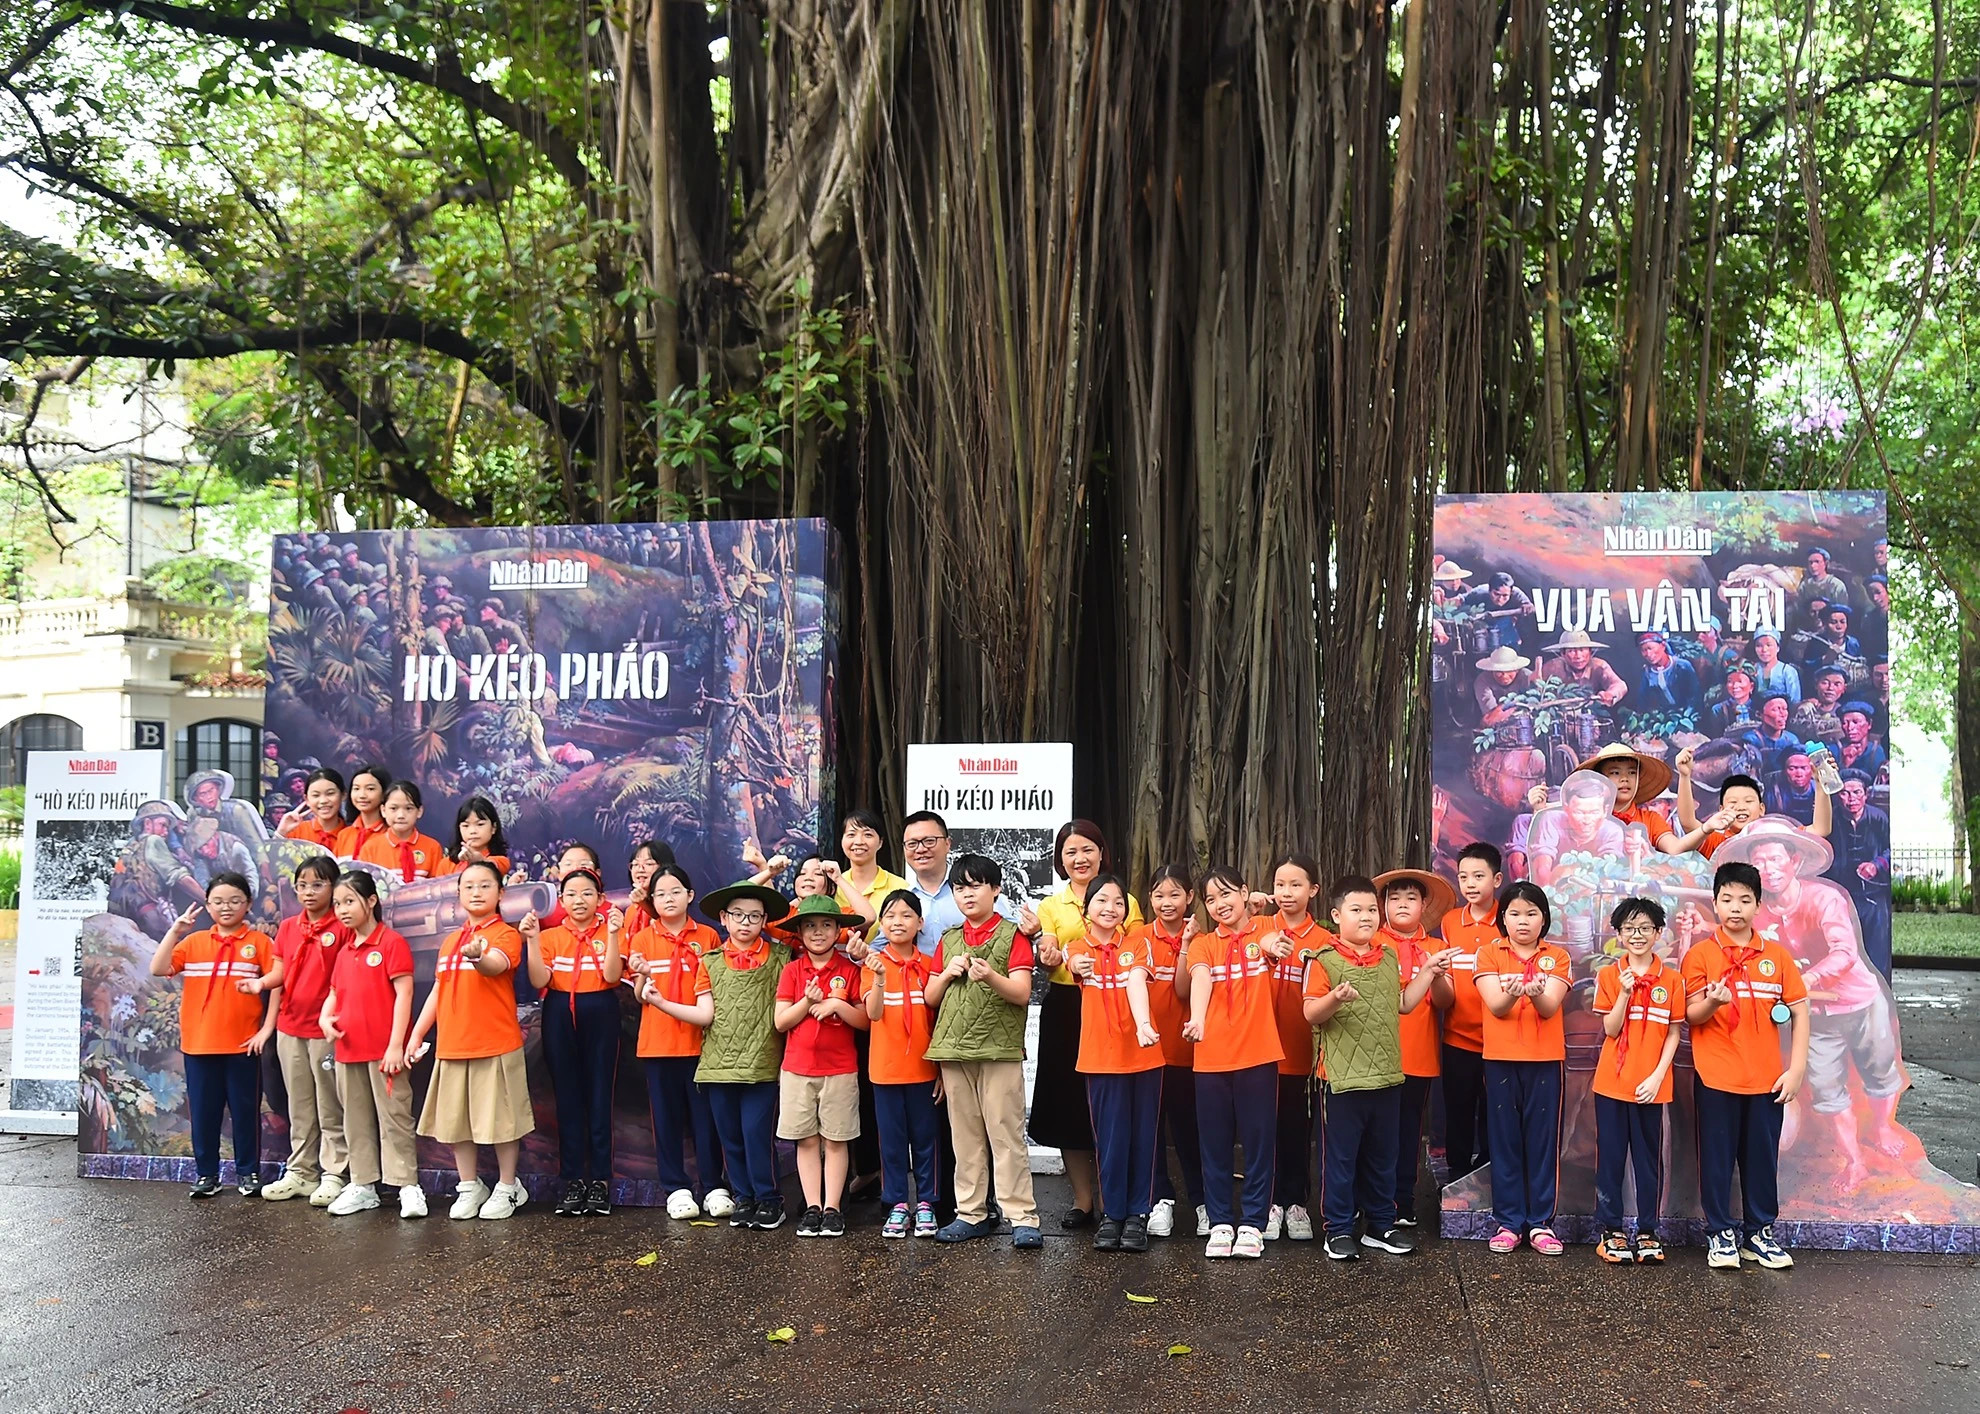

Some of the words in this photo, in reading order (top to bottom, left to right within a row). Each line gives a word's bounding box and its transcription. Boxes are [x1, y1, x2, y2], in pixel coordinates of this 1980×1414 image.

[1604, 526, 1663, 550] Nhân
[1666, 526, 1712, 550] Dân
[490, 559, 545, 585] Nhân
[546, 558, 588, 583] Dân
[1532, 588, 1615, 632] VUA
[1626, 578, 1711, 638] VẬN
[404, 645, 457, 702] HÒ
[469, 644, 546, 701] KÉO
[560, 642, 669, 700] PHÁO
[141, 725, 160, 746] B
[69, 760, 95, 771] Nhân
[97, 760, 117, 771] Dân
[958, 758, 991, 772] Nhân
[993, 758, 1018, 772] Dân
[68, 789, 95, 810] KÉO
[924, 784, 948, 810] HÒ
[957, 785, 993, 810] KÉO
[1001, 785, 1053, 810] PHÁO
